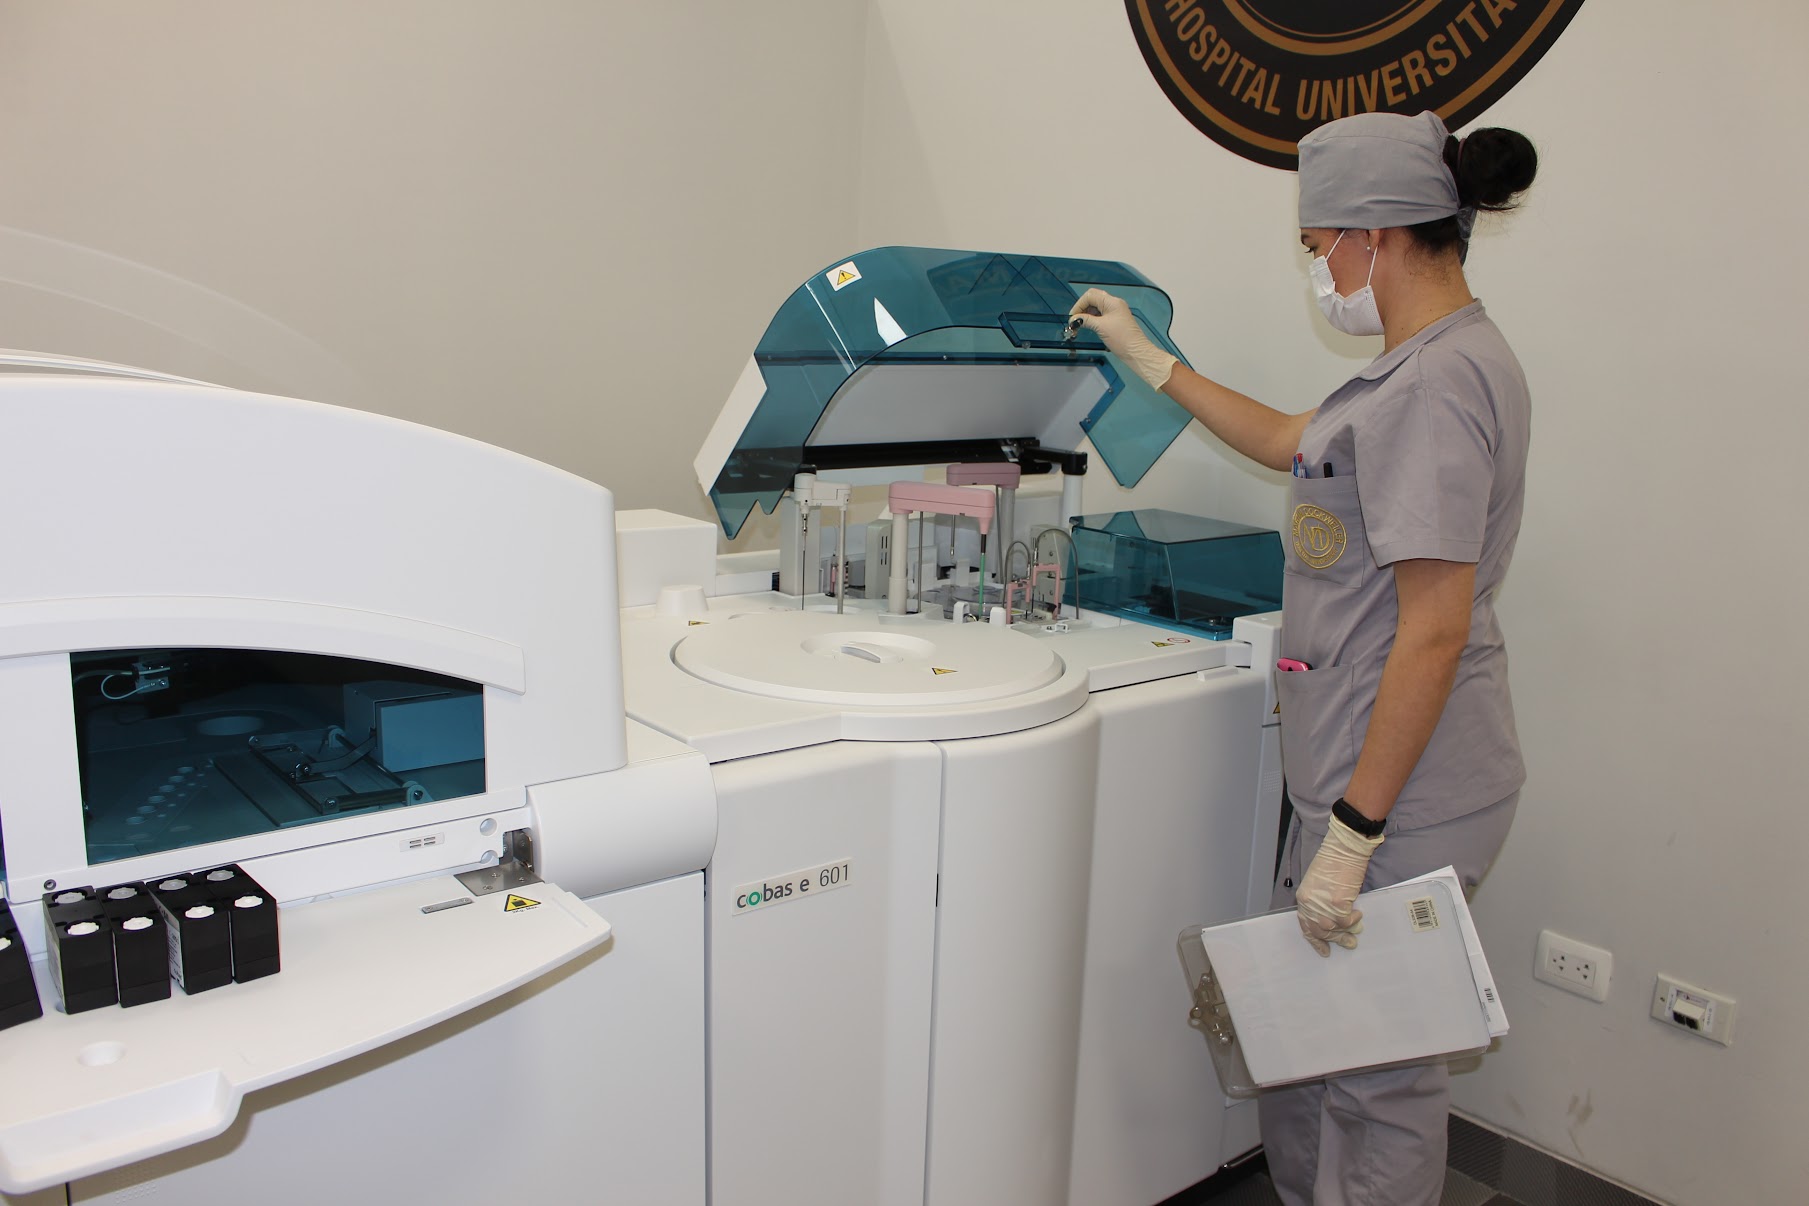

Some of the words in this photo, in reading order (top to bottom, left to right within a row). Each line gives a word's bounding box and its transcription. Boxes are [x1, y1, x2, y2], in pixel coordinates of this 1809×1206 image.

[1165, 0, 1281, 116] HOSPITAL
[1296, 0, 1518, 121] UNIVERSITA
[737, 883, 792, 908] cobas
[800, 878, 810, 892] e
[819, 864, 848, 887] 601
